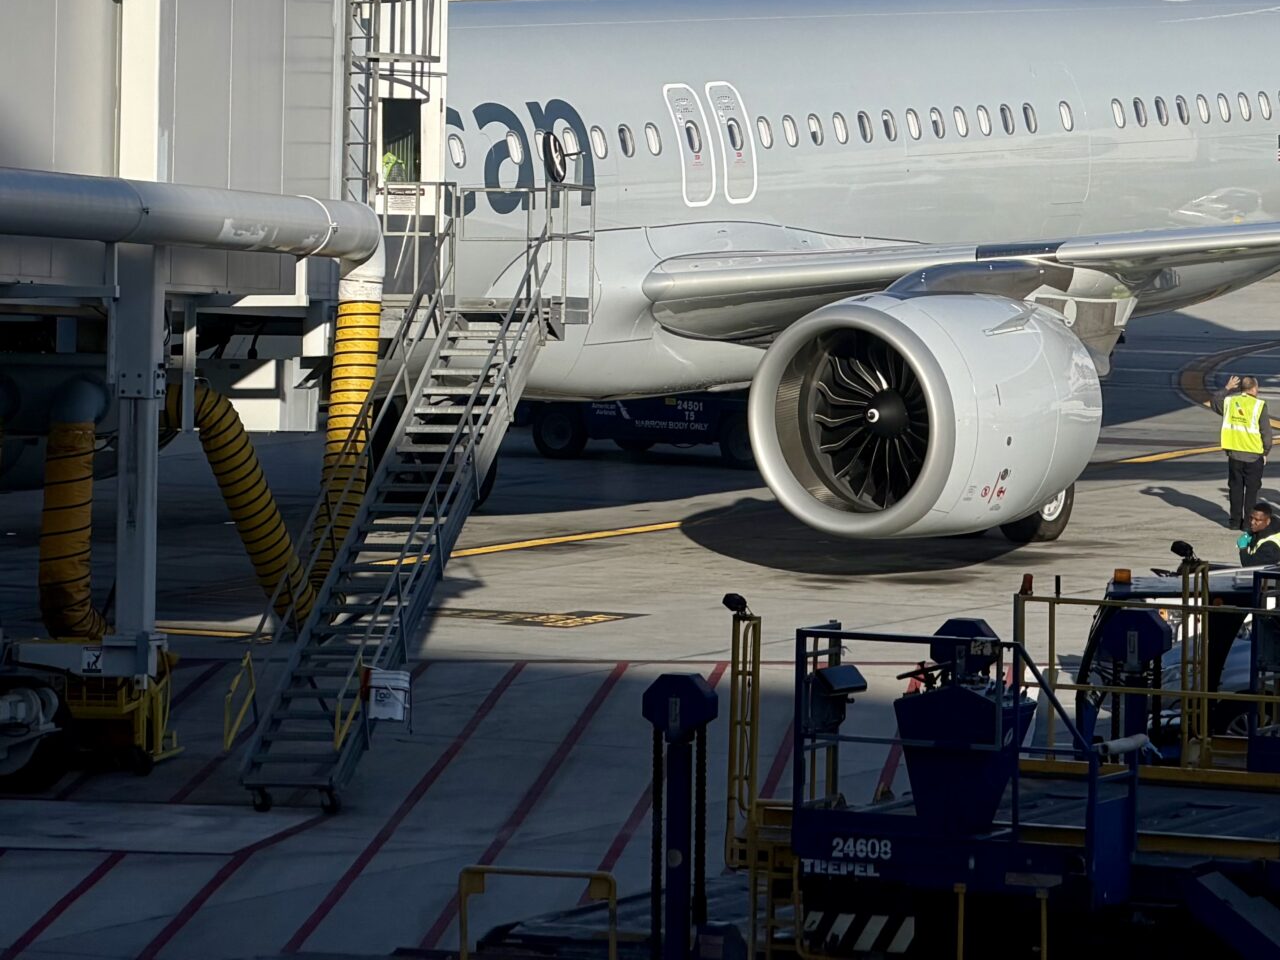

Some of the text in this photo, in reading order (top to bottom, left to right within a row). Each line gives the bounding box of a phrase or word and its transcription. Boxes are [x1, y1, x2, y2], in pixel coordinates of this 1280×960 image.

[677, 400, 704, 411] 24501
[635, 419, 709, 431] NARROW BODY ONLY
[832, 837, 892, 859] 24608
[801, 858, 880, 877] TREPEL
